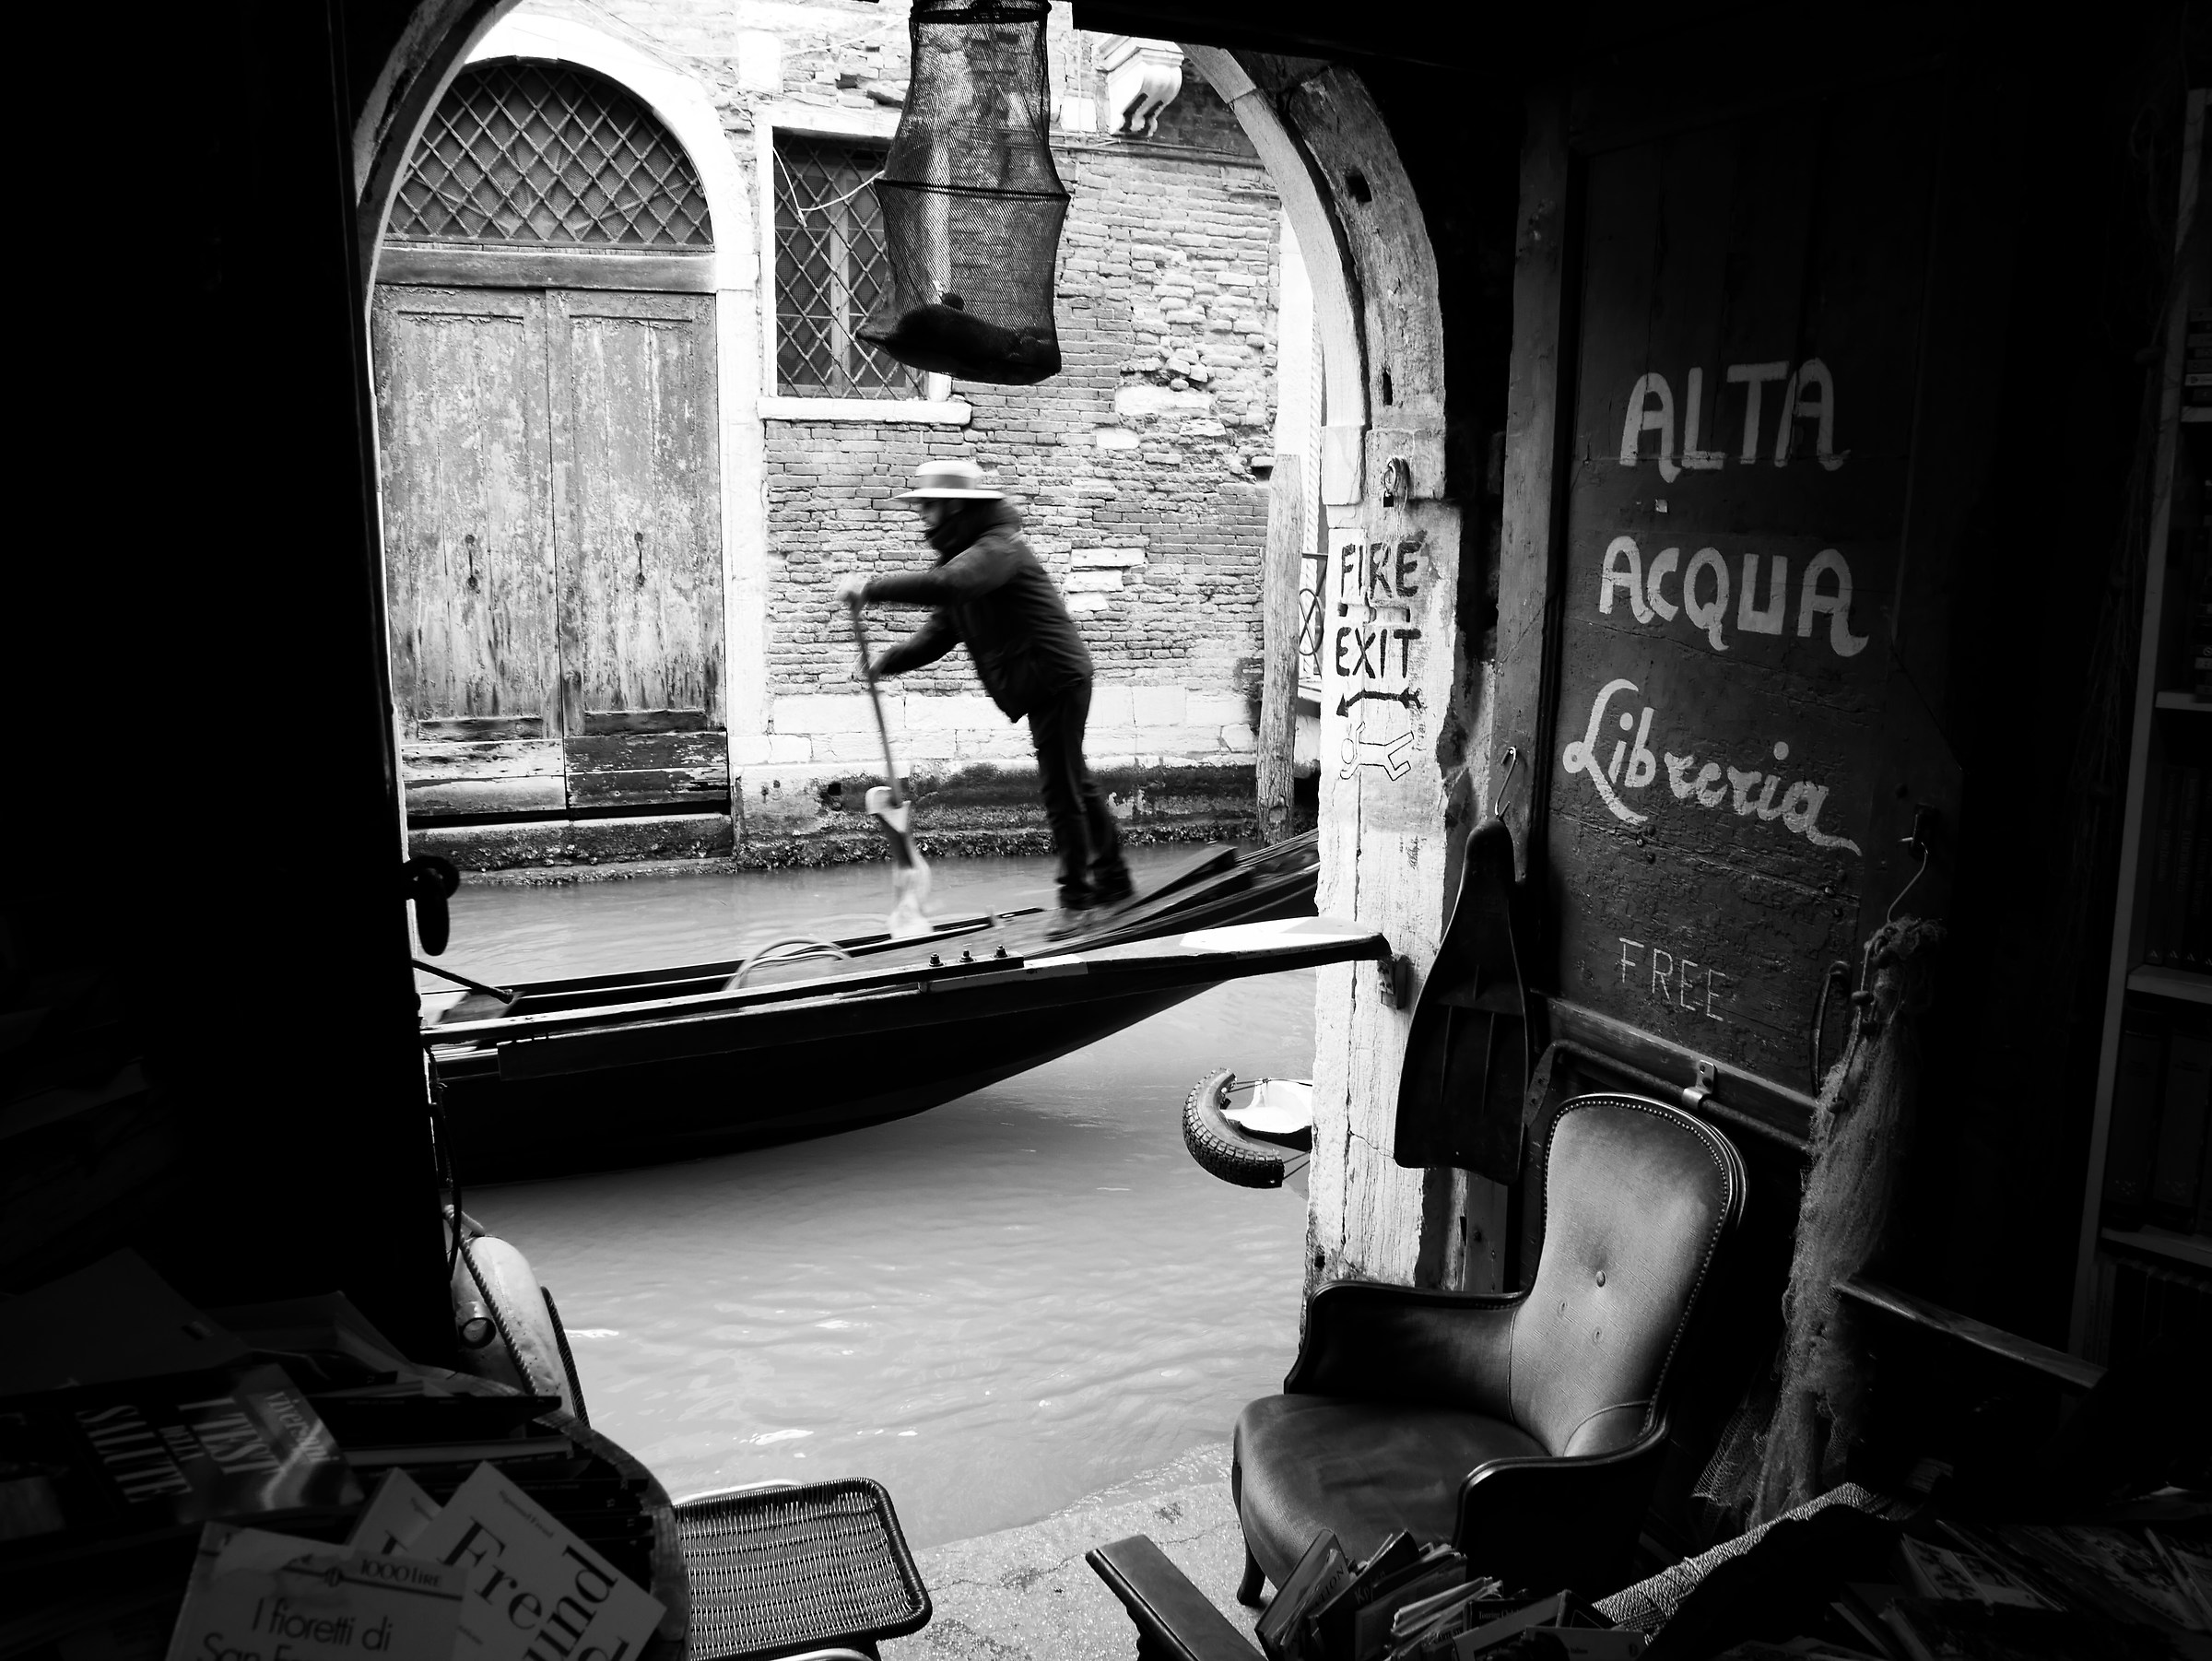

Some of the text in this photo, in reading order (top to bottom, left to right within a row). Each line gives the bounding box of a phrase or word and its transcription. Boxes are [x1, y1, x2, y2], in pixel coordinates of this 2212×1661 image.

[1619, 357, 1852, 483] ALTA
[1341, 532, 1428, 599] FIRE
[1599, 536, 1869, 657] ACQUA
[1335, 626, 1421, 679] EXIT
[1563, 678, 1863, 856] Libreria
[1619, 937, 1726, 1021] FREE
[75, 1404, 193, 1504] SALUTE
[268, 1597, 356, 1646] fioretti
[362, 1616, 393, 1652] di
